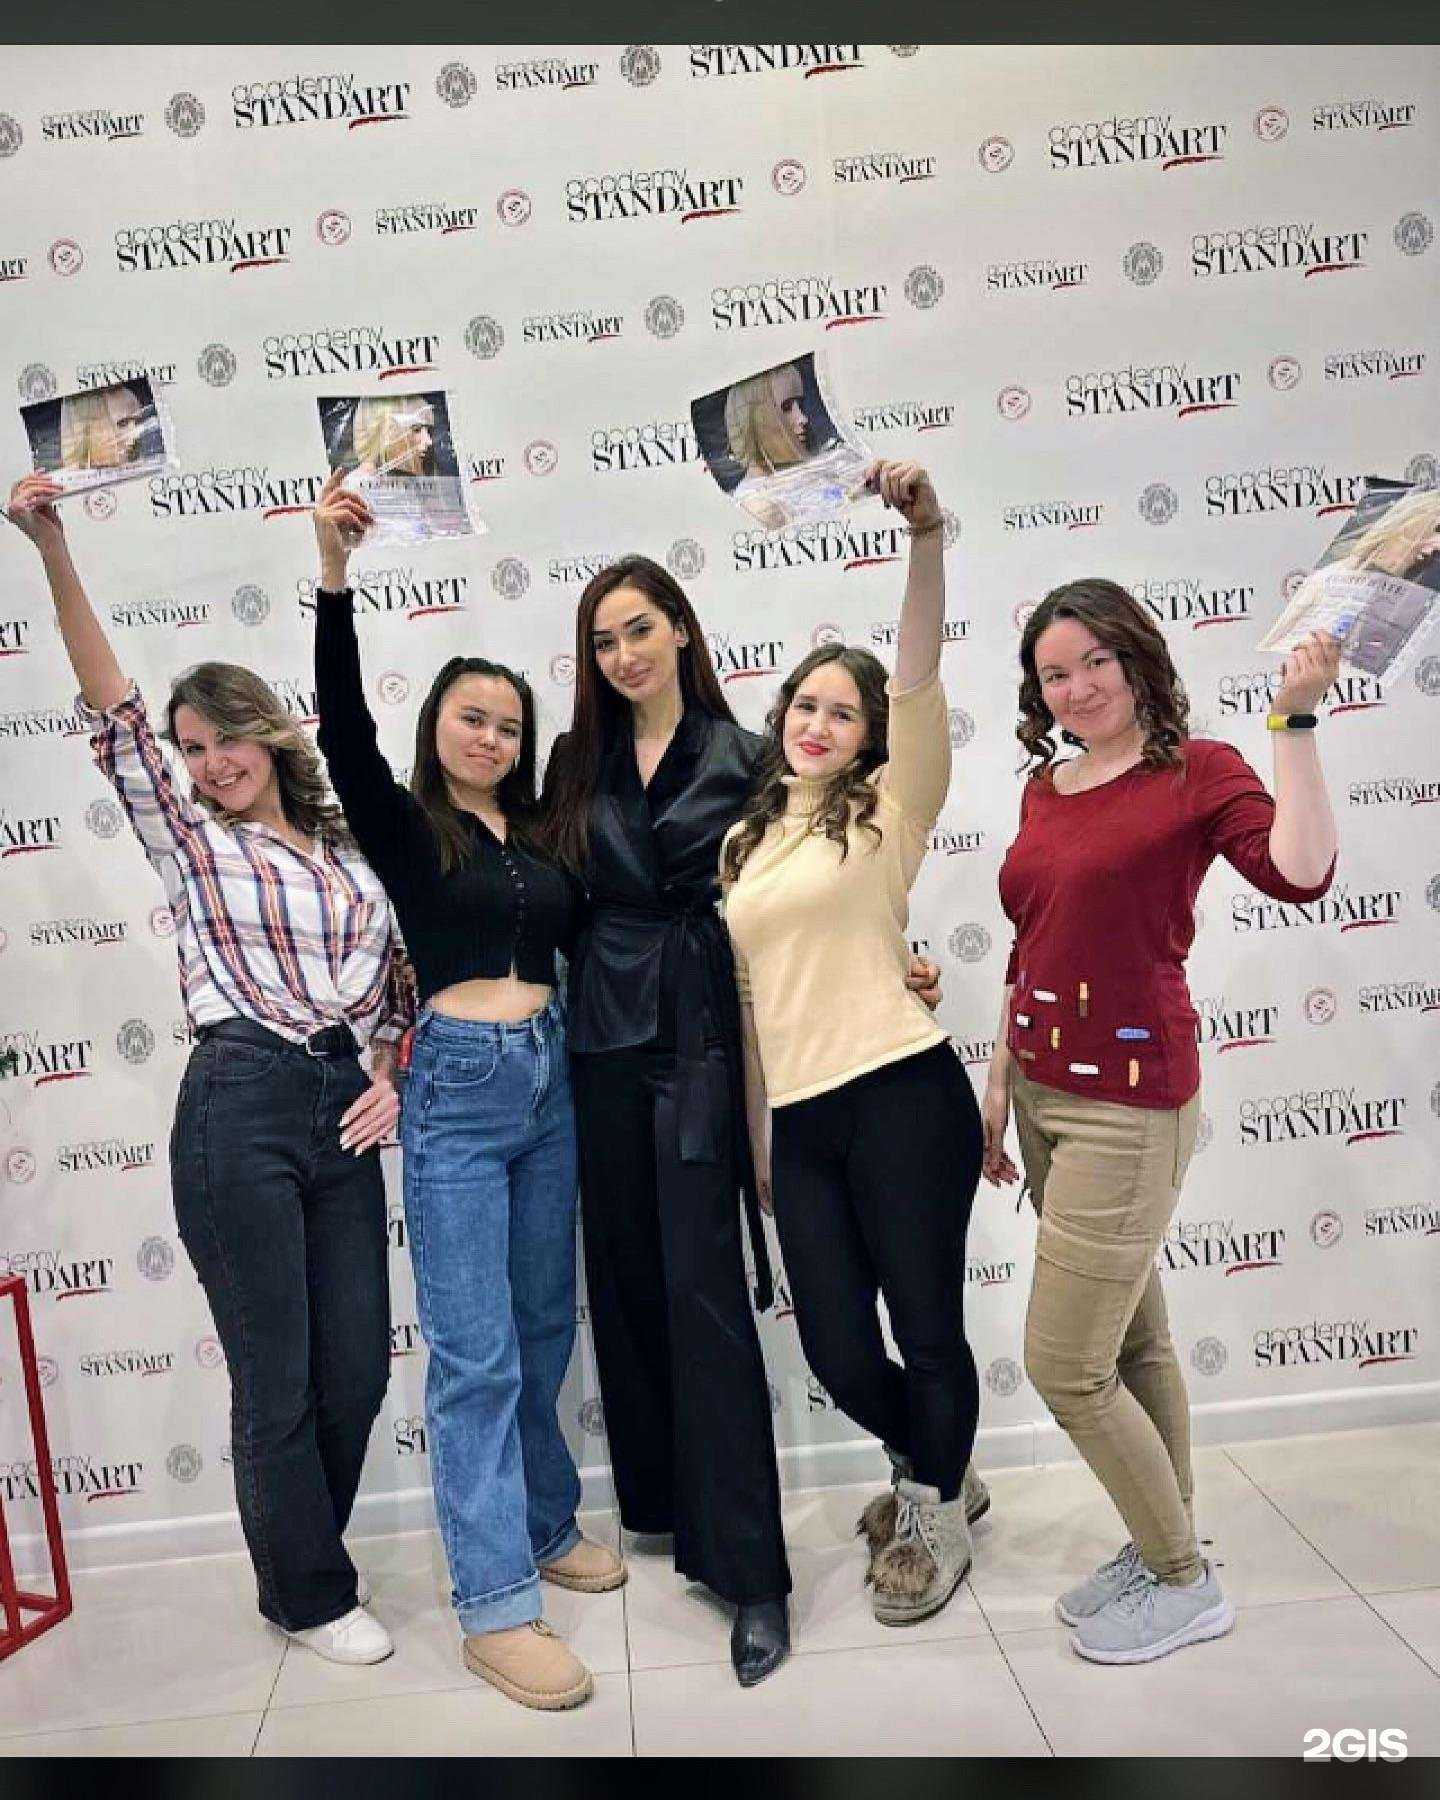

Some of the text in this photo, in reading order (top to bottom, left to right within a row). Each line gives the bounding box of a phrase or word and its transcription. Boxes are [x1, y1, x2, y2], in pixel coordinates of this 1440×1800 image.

[232, 72, 354, 103] academy
[496, 64, 598, 91] STANDART
[233, 82, 410, 128] STANDART
[1313, 105, 1416, 130] STANDART
[42, 113, 145, 141] STANDART
[1049, 114, 1172, 143] academy
[1051, 125, 1227, 169] STANDART
[566, 167, 687, 199] academy
[834, 157, 936, 183] STANDART
[567, 178, 744, 222] STANDART
[115, 214, 236, 246] academy
[375, 209, 478, 235] STANDART
[1193, 222, 1315, 252] academy
[117, 227, 291, 272] STANDART
[1194, 233, 1368, 277] STANDART
[712, 275, 834, 305] academy
[988, 264, 1089, 290] STANDART
[713, 284, 887, 330] STANDART
[263, 325, 384, 355] academy
[524, 316, 624, 343] STANDART
[266, 336, 440, 380] STANDART
[1325, 354, 1425, 380] STANDART
[1066, 361, 1187, 392] academy
[1067, 373, 1240, 416] STANDART
[854, 406, 955, 432] STANDART
[150, 465, 270, 493] academy
[1205, 464, 1325, 494] academy
[151, 477, 322, 518] STANDART
[1003, 505, 1103, 531] STANDART
[734, 527, 904, 571] STANDART
[112, 604, 209, 628] STANDART
[1233, 892, 1402, 932] STANDART
[30, 921, 127, 946] STANDART
[1240, 1087, 1354, 1116] academy
[1240, 1098, 1407, 1144] STANDART
[58, 1144, 153, 1171] STANDART
[1254, 1317, 1371, 1346] academy
[1255, 1328, 1418, 1368] STANDART
[81, 1352, 175, 1377] STANDART
